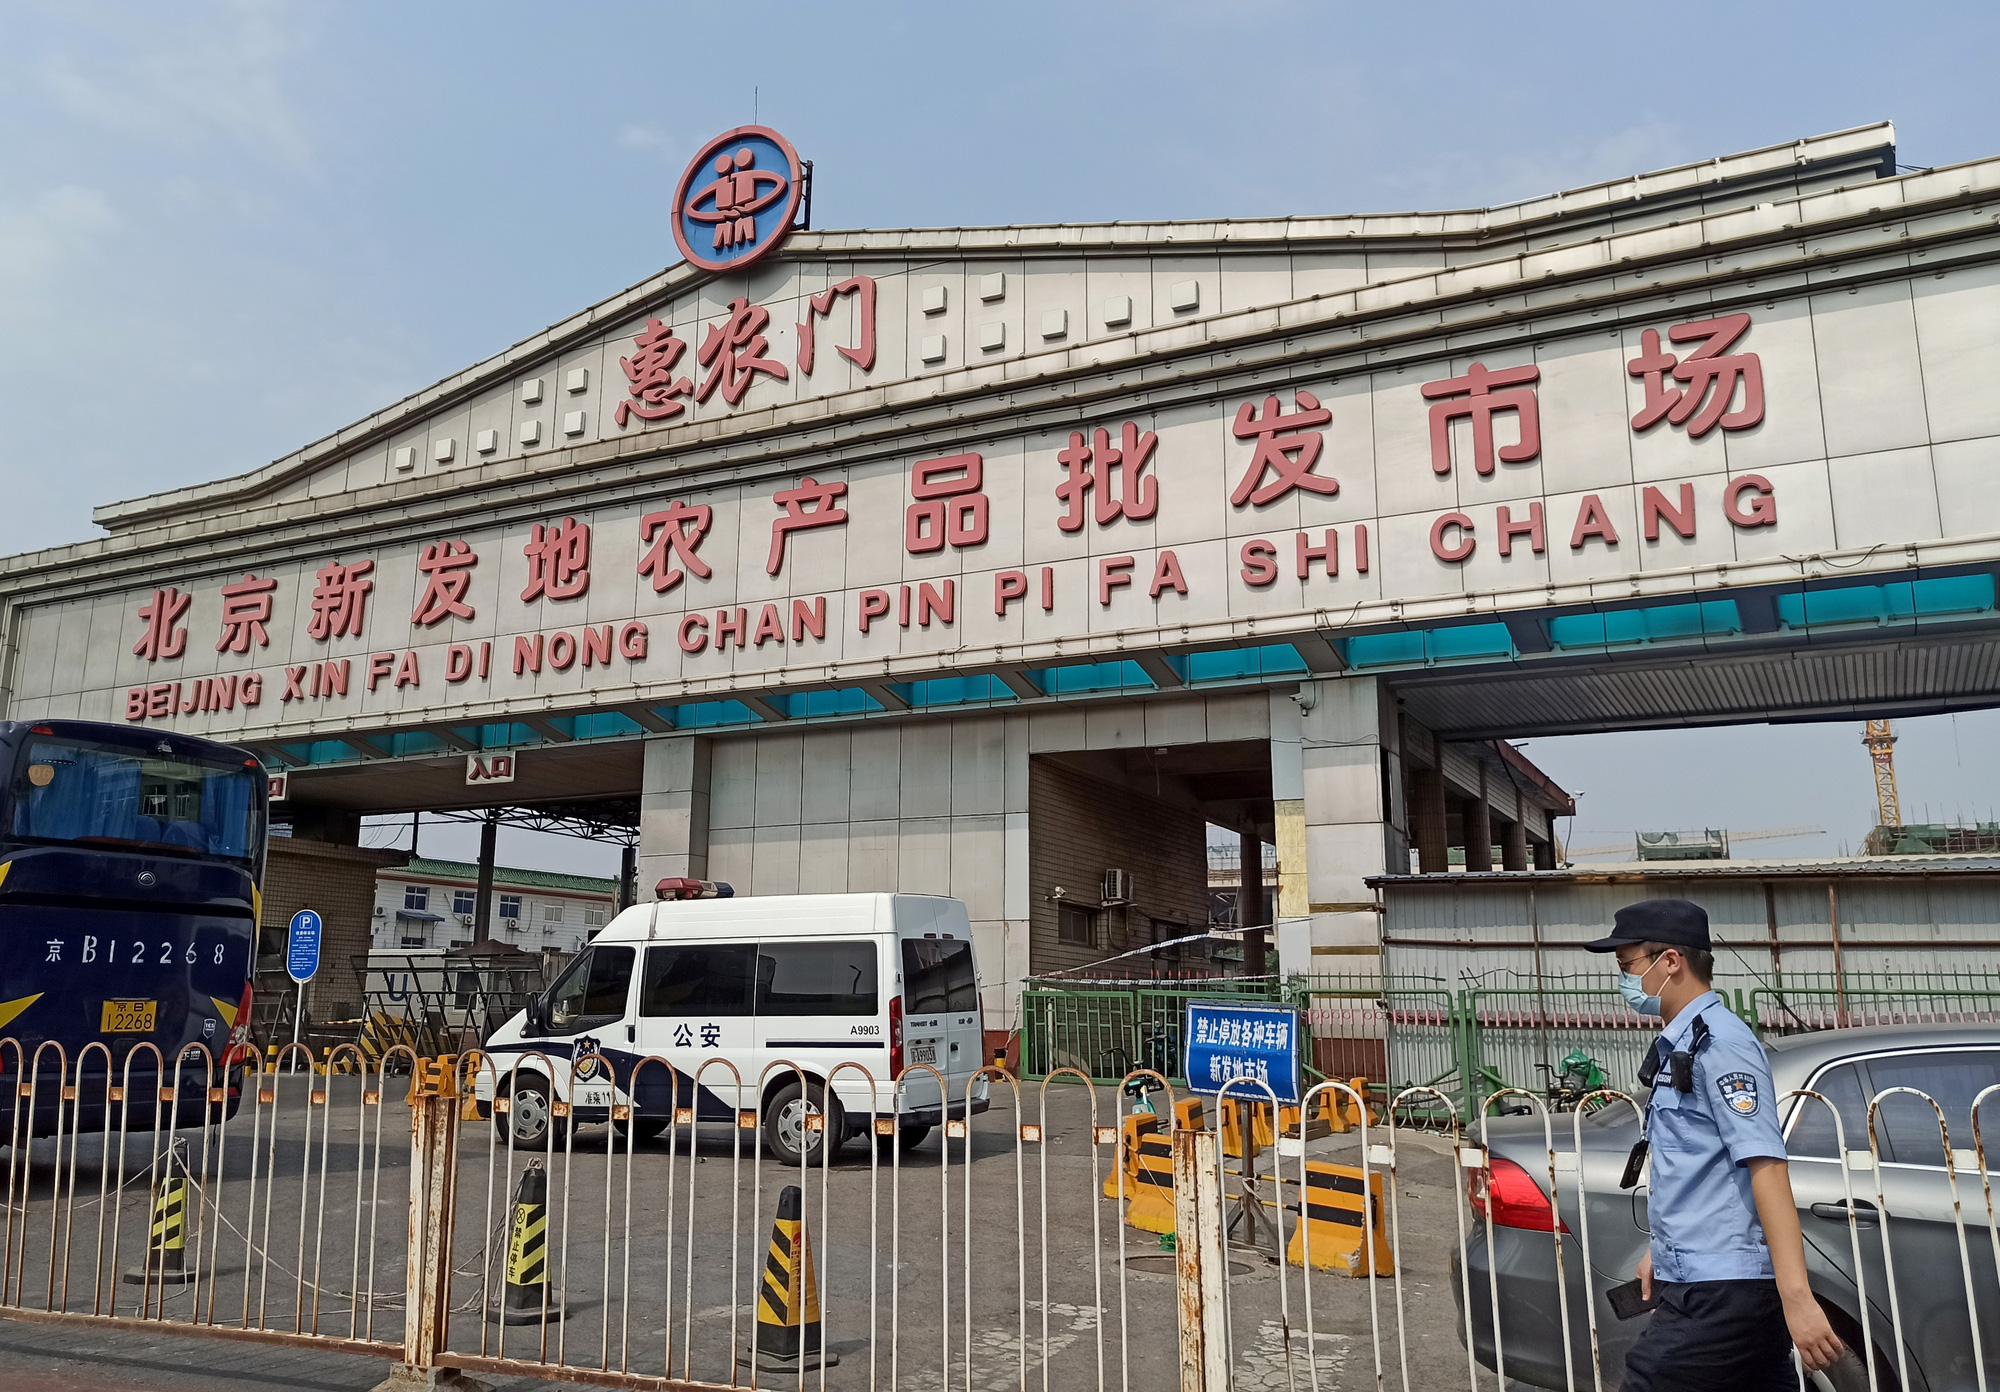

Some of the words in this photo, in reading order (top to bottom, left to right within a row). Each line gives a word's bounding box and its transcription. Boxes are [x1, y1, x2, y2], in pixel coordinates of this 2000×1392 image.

[615, 275, 877, 427] 惠农门
[133, 312, 1766, 663] 北京新发地农产品批发市场
[126, 671, 262, 721] BEIJING
[281, 657, 351, 703] XIN
[367, 650, 421, 692] FA
[445, 641, 491, 683] DI
[513, 620, 649, 676] NONG
[678, 595, 827, 655] CHAN
[859, 578, 955, 634] PIN
[994, 566, 1054, 617] PI
[1100, 549, 1189, 607] FA
[1240, 523, 1370, 587] SHI
[1429, 474, 1778, 563] CHANG
[469, 755, 513, 781] 入口
[302, 916, 311, 928] P
[107, 1013, 153, 1030] 12268
[673, 1022, 721, 1049] 公安
[850, 1025, 880, 1035] A9903
[1195, 1016, 1289, 1051] 禁止停放各种车辆
[1209, 1054, 1270, 1087] 新发地市场
[585, 1091, 619, 1105] 准乘11
[508, 1227, 522, 1278] 禁止停车
